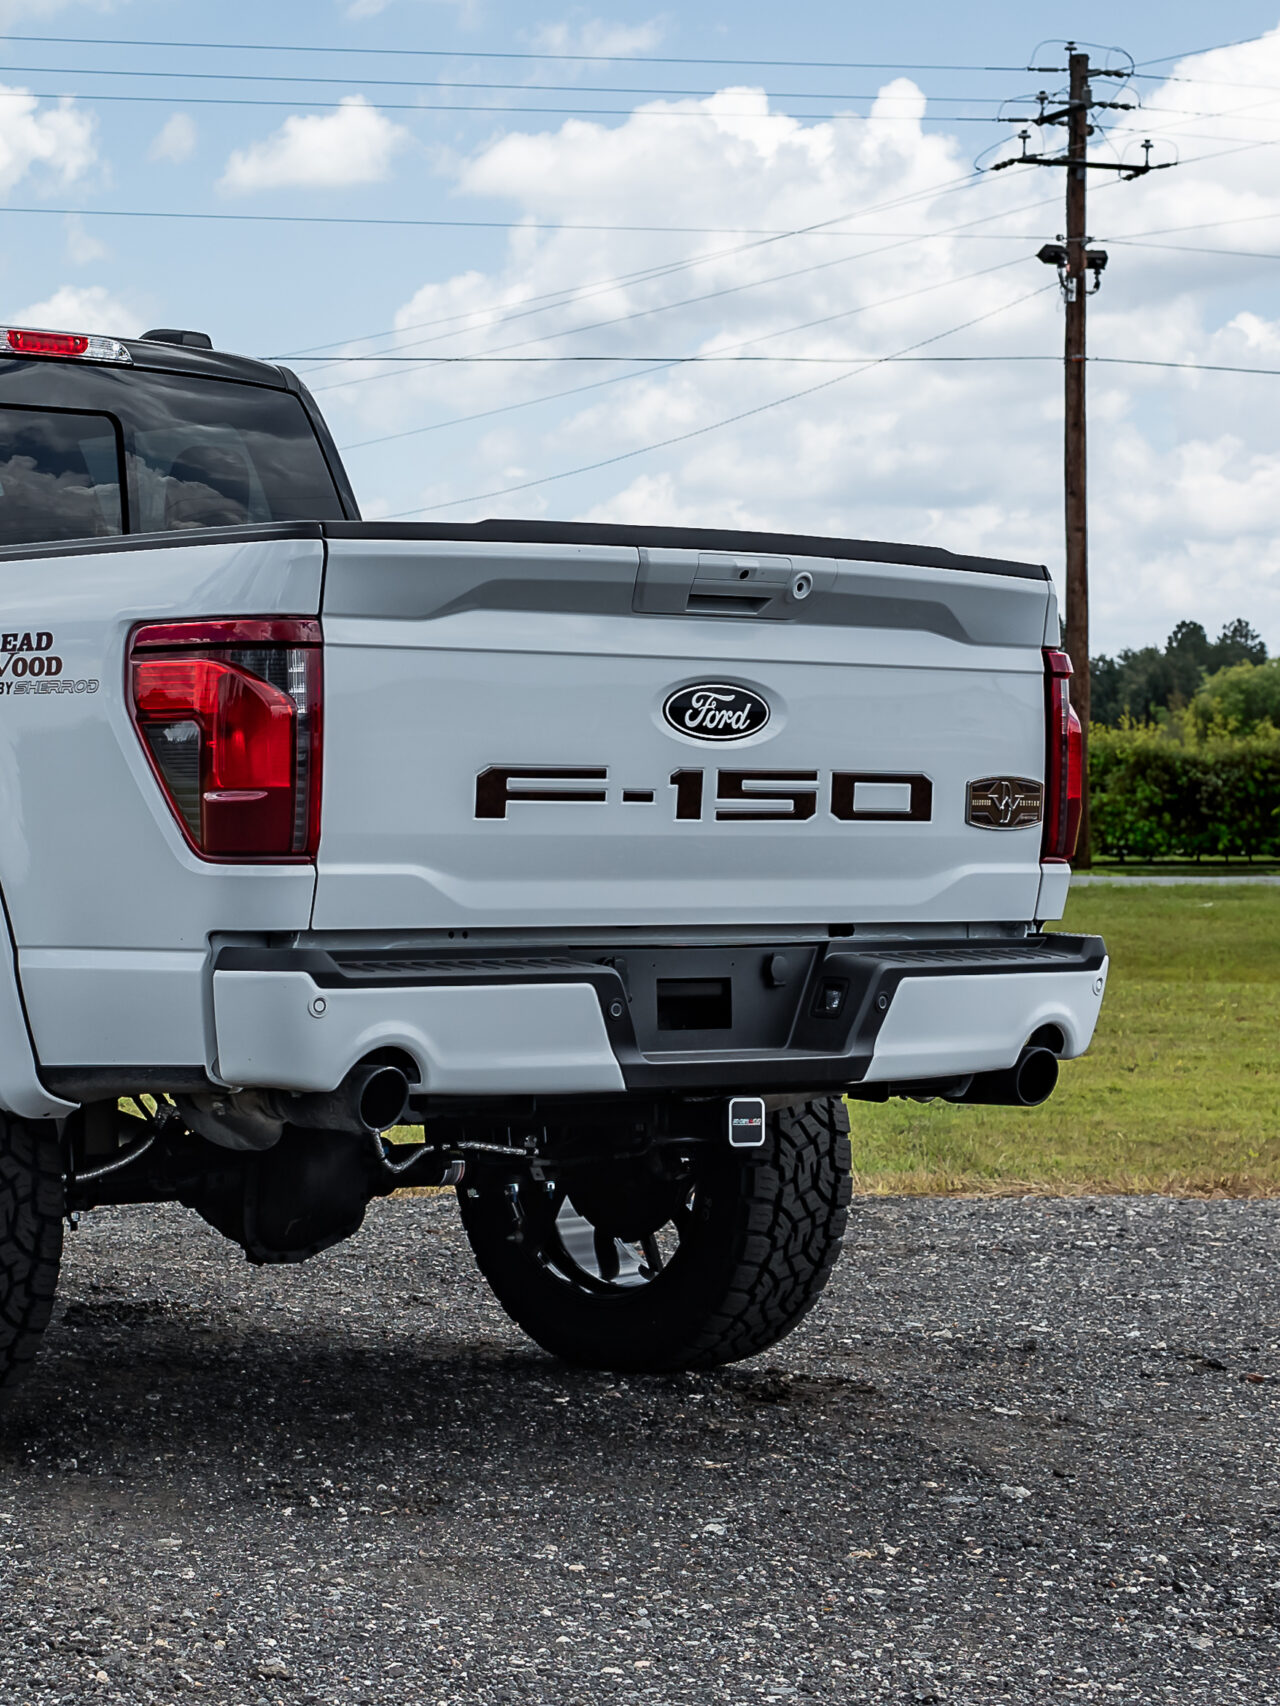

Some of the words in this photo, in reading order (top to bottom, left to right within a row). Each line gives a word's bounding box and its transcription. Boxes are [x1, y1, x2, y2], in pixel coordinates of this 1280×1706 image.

[13, 679, 100, 695] SHERROD
[684, 691, 752, 729] Ford
[473, 765, 934, 822] F-150
